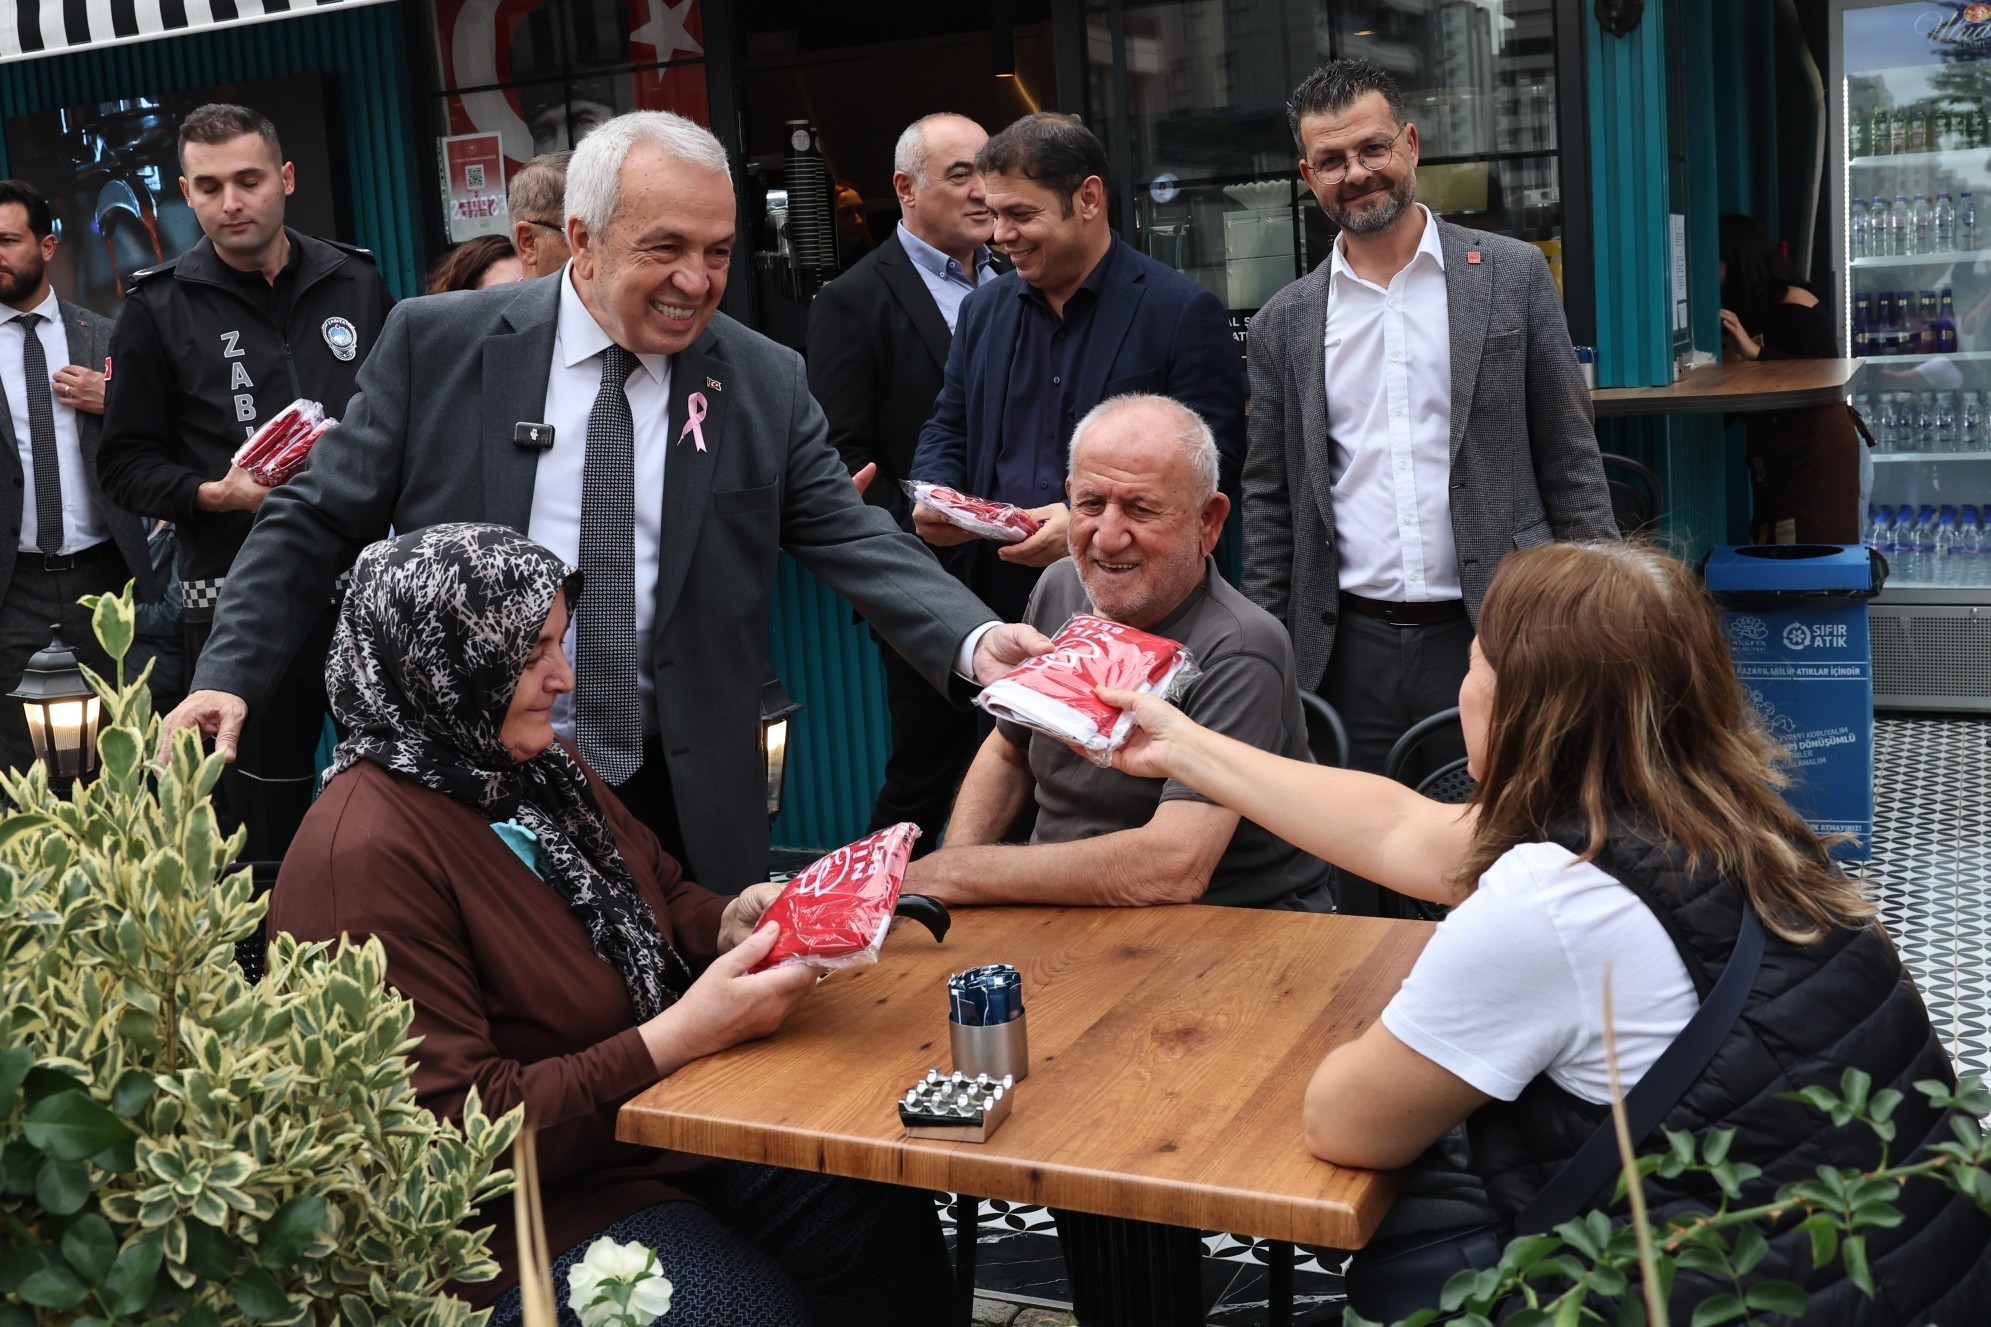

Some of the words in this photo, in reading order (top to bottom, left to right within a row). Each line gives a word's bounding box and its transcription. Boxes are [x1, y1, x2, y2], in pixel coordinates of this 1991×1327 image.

[1812, 624, 1847, 636] SIFIR
[1814, 636, 1847, 648] ATIK
[1796, 667, 1829, 676] ATIKLAR
[1830, 665, 1861, 677] İÇİNDİR
[1806, 727, 1849, 738] KORUYALIM
[1799, 732, 1857, 749] DÖNÜŞÜMLÜ
